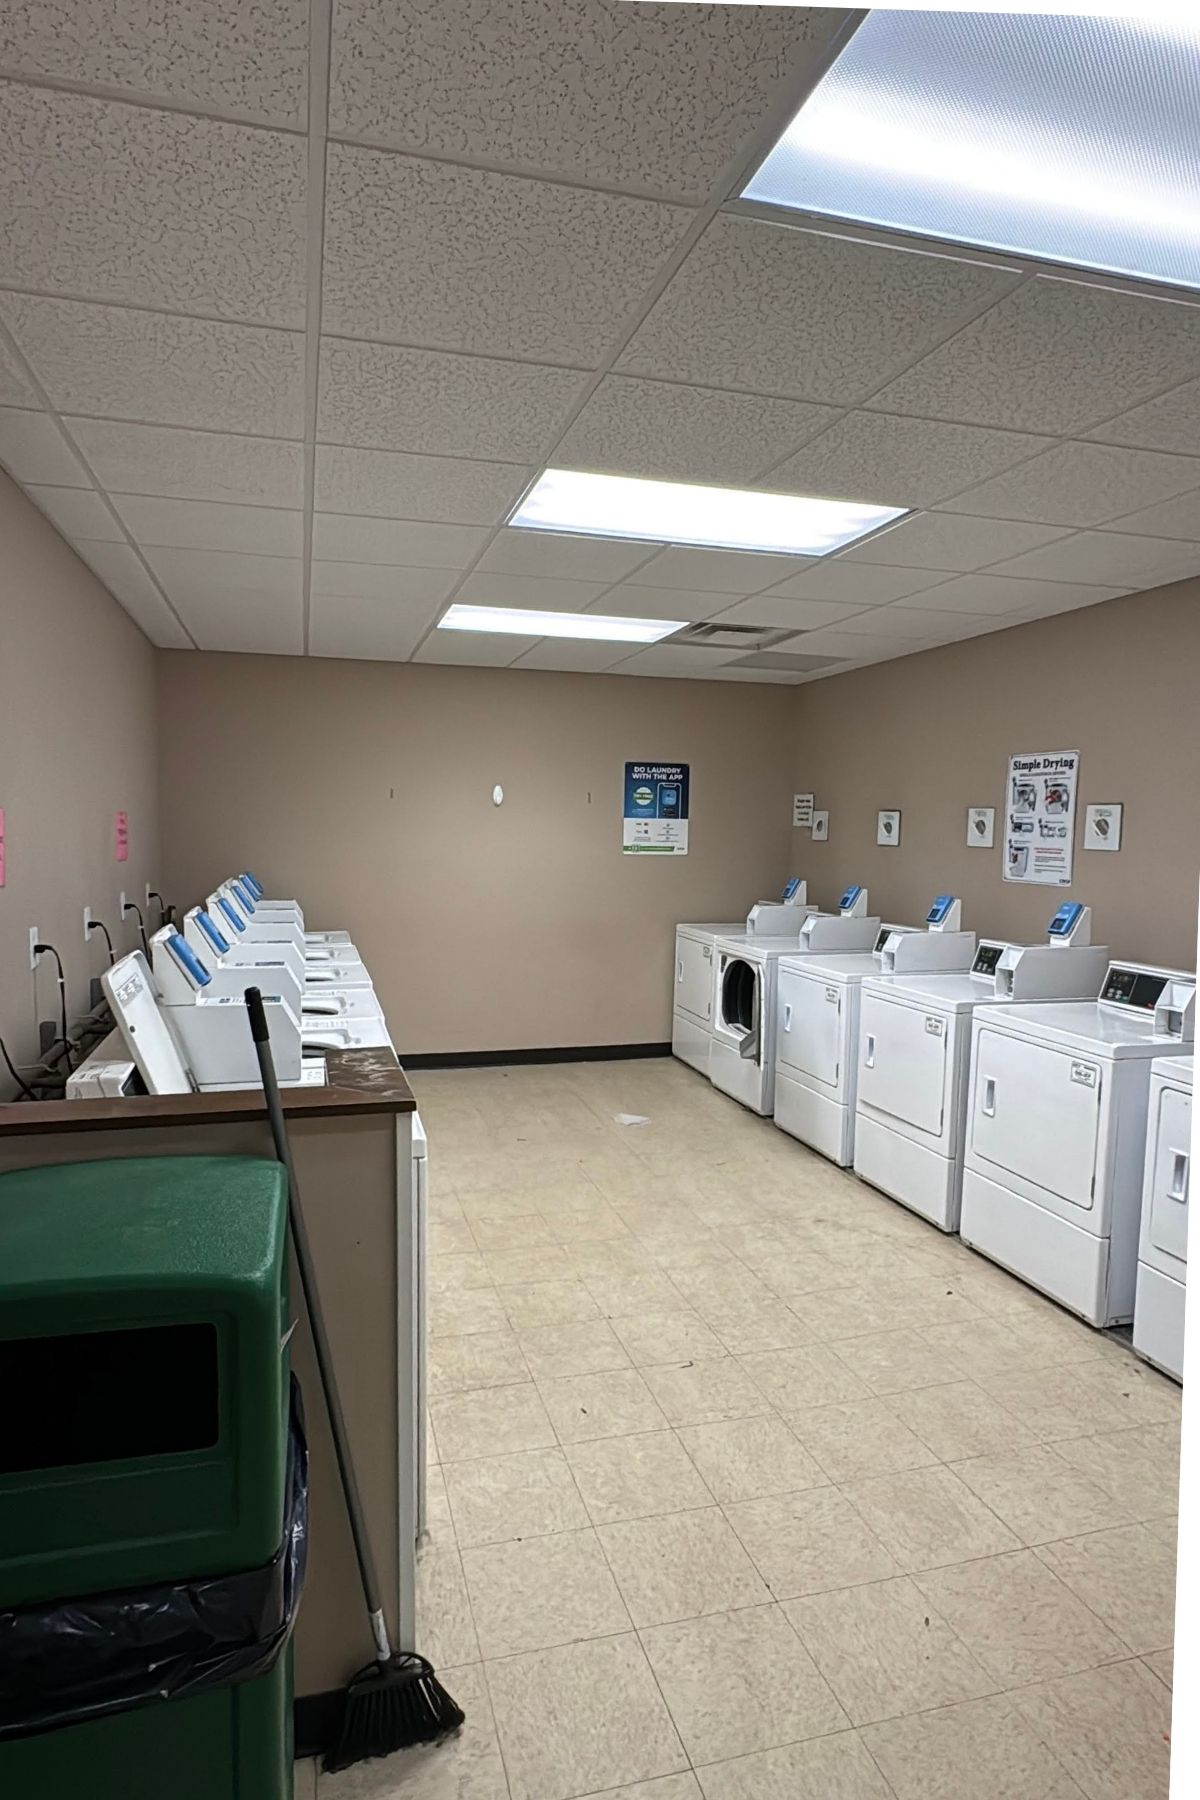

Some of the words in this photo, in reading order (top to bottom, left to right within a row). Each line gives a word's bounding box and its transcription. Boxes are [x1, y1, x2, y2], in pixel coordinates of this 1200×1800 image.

[647, 766, 681, 774] LAUNDRY
[1013, 759, 1041, 772] Simple
[1043, 757, 1074, 770] Drying
